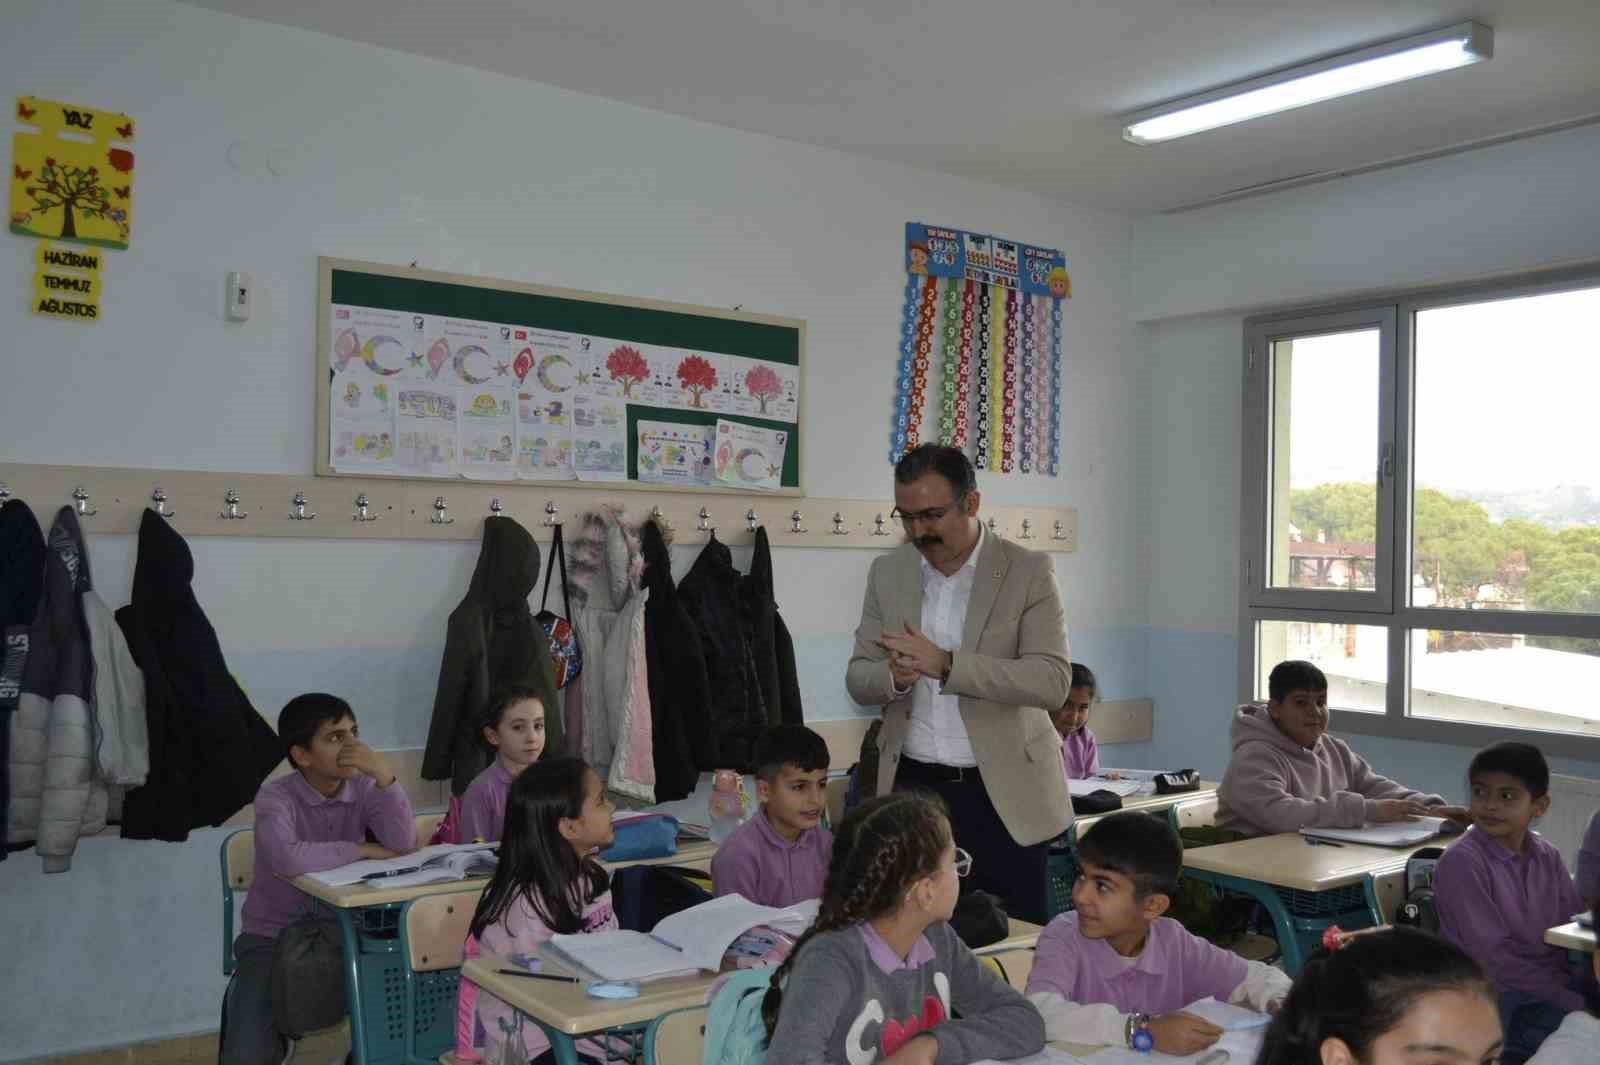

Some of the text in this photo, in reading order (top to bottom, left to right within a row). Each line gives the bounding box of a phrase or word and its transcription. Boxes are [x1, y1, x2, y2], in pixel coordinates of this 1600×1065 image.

[62, 108, 94, 130] YAZ
[43, 250, 98, 269] HAZİRAN
[43, 275, 92, 294] TEMMUZ
[39, 298, 97, 318] AĞUSTOS
